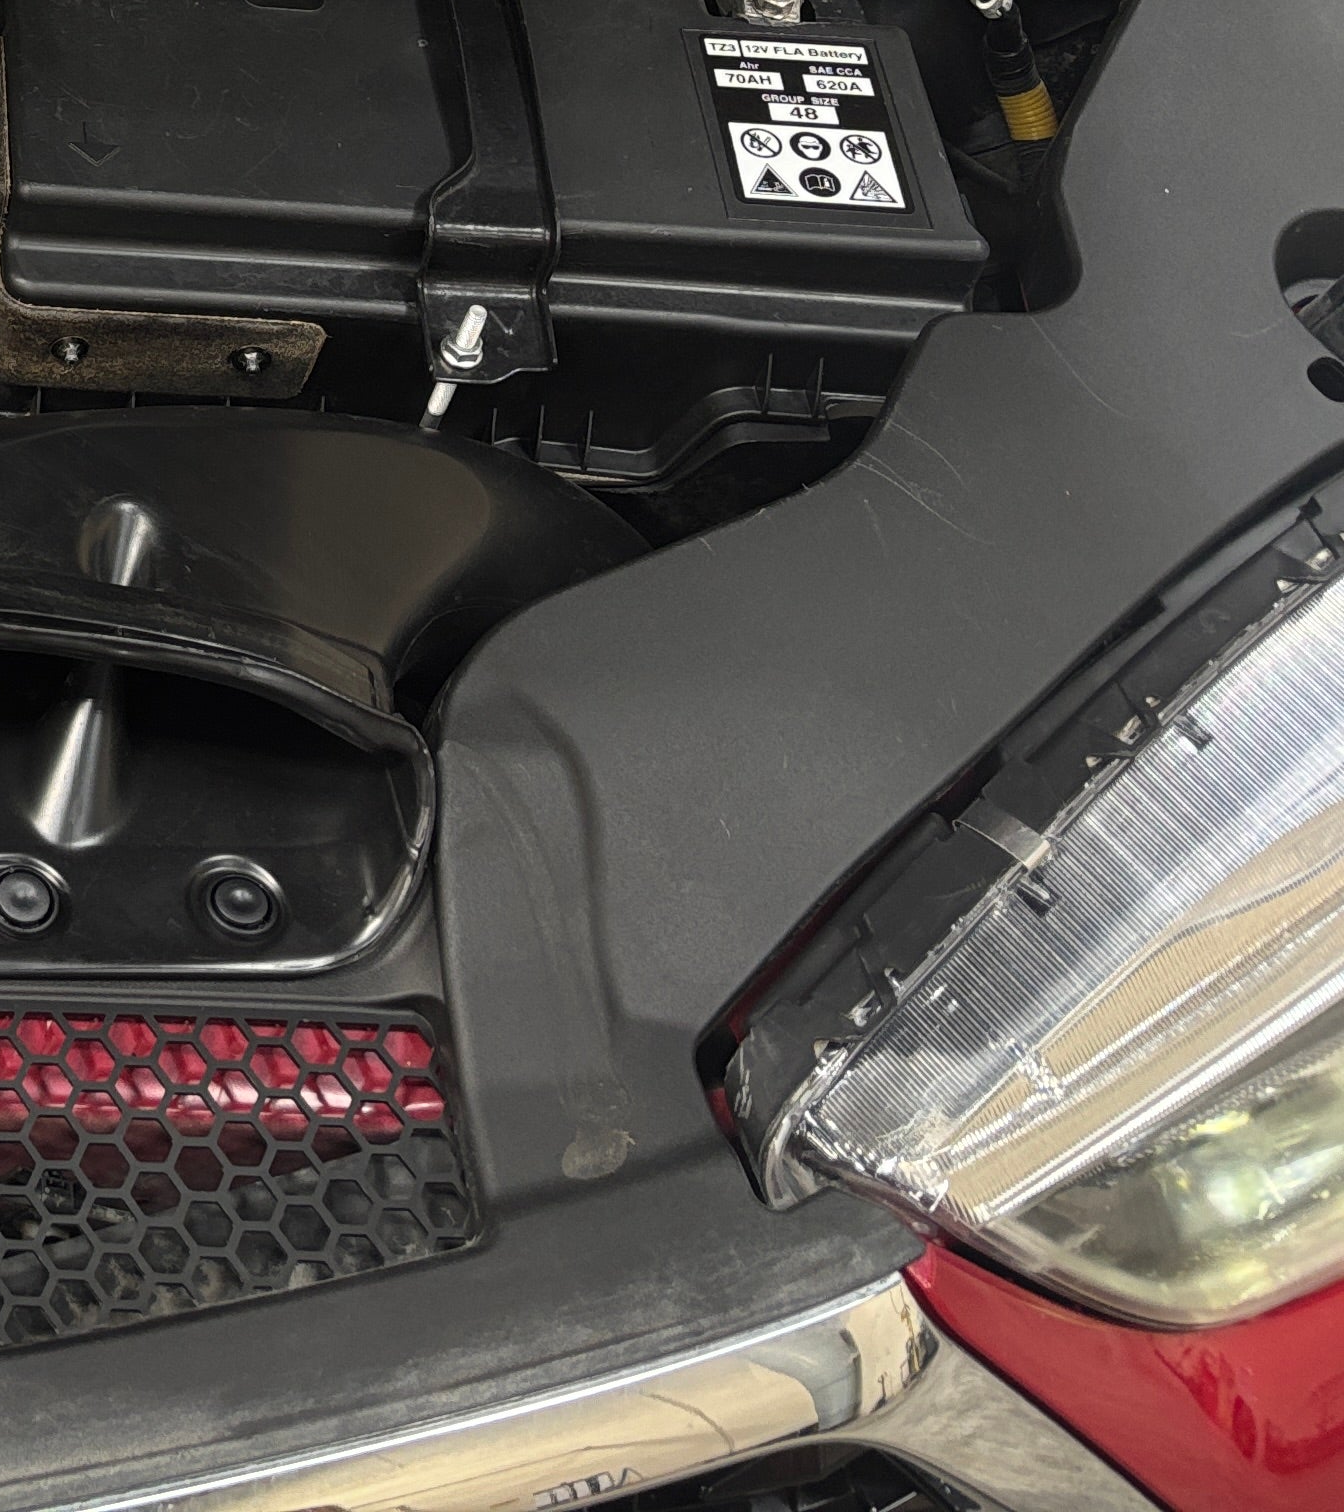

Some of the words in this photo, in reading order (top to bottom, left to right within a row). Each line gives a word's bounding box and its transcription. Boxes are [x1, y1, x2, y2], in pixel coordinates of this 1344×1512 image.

[709, 42, 737, 53] TZ3
[745, 45, 768, 55] 12V
[774, 46, 804, 57] FLA
[808, 48, 863, 62] Battery
[740, 61, 760, 71] Ahr
[809, 65, 834, 76] SAE
[836, 67, 863, 77] CCA
[725, 72, 773, 86] 70AH
[816, 79, 863, 93] 620A
[761, 93, 805, 104] GROUP
[810, 96, 840, 107] SIZE
[789, 106, 819, 121] 48
